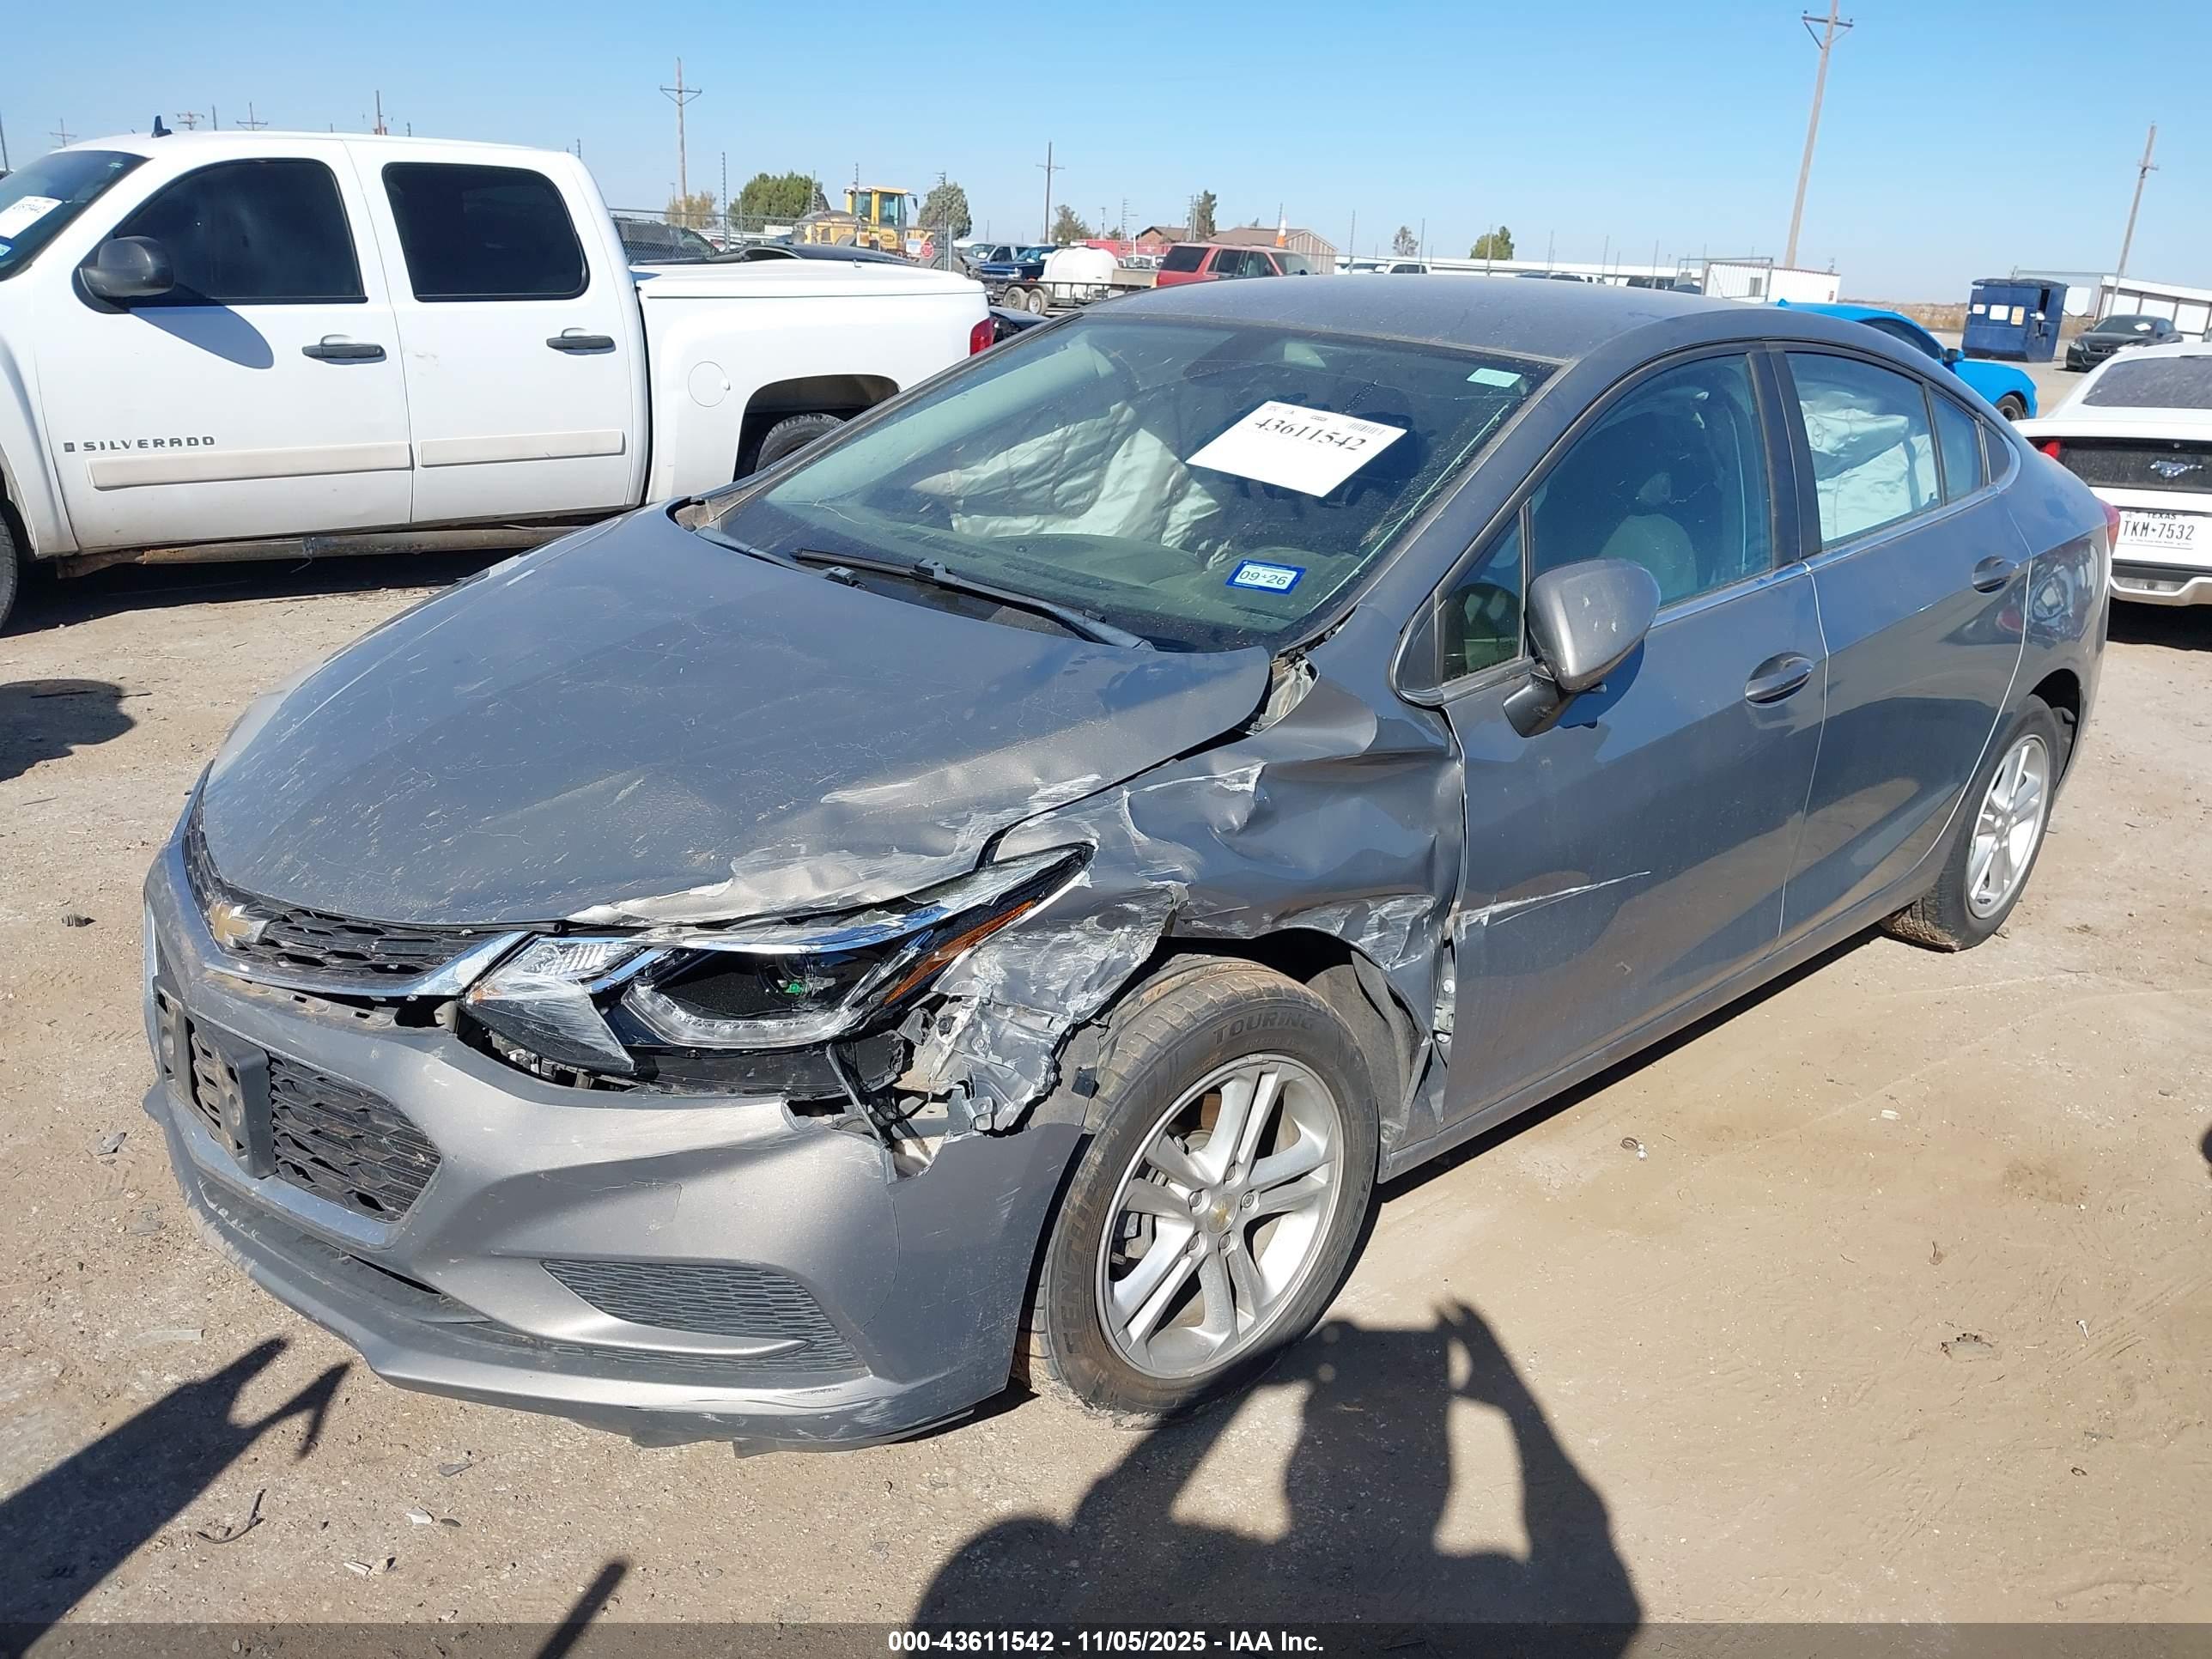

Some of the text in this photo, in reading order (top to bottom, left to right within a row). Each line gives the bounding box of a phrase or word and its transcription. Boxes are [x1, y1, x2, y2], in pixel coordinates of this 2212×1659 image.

[83, 436, 216, 452] SILVERADO
[1255, 418, 1366, 451] 43611542
[2147, 511, 2177, 520] TEXAS
[1212, 1012, 1316, 1045] TOURING
